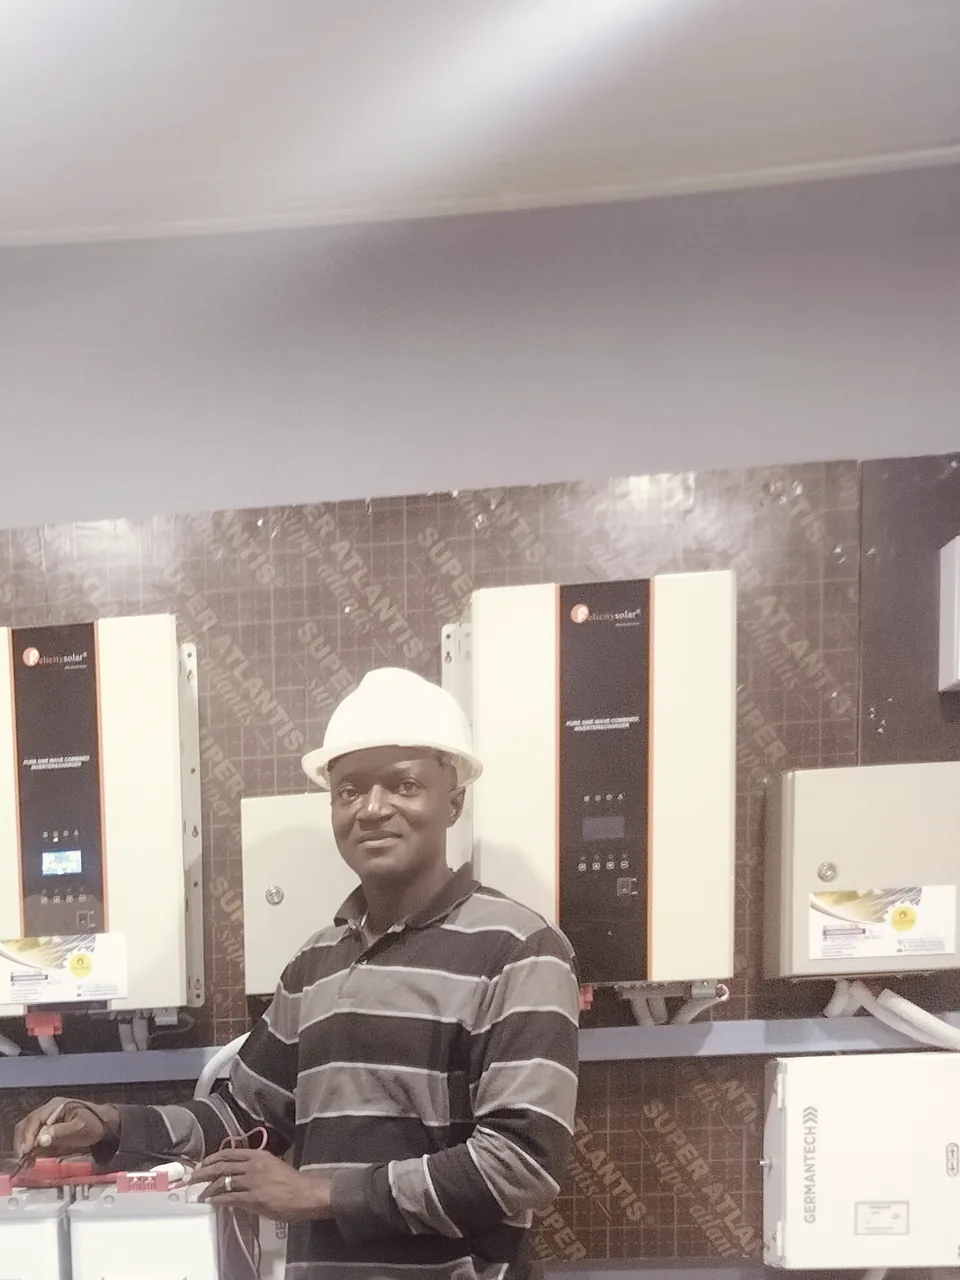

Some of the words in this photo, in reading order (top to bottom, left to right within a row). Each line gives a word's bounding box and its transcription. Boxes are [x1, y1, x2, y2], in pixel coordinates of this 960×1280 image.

[329, 540, 424, 659] ATLANTIS
[211, 632, 304, 751] ATLANTIS
[642, 1100, 710, 1181] SUPER
[803, 1125, 817, 1225] GERMANTECH
